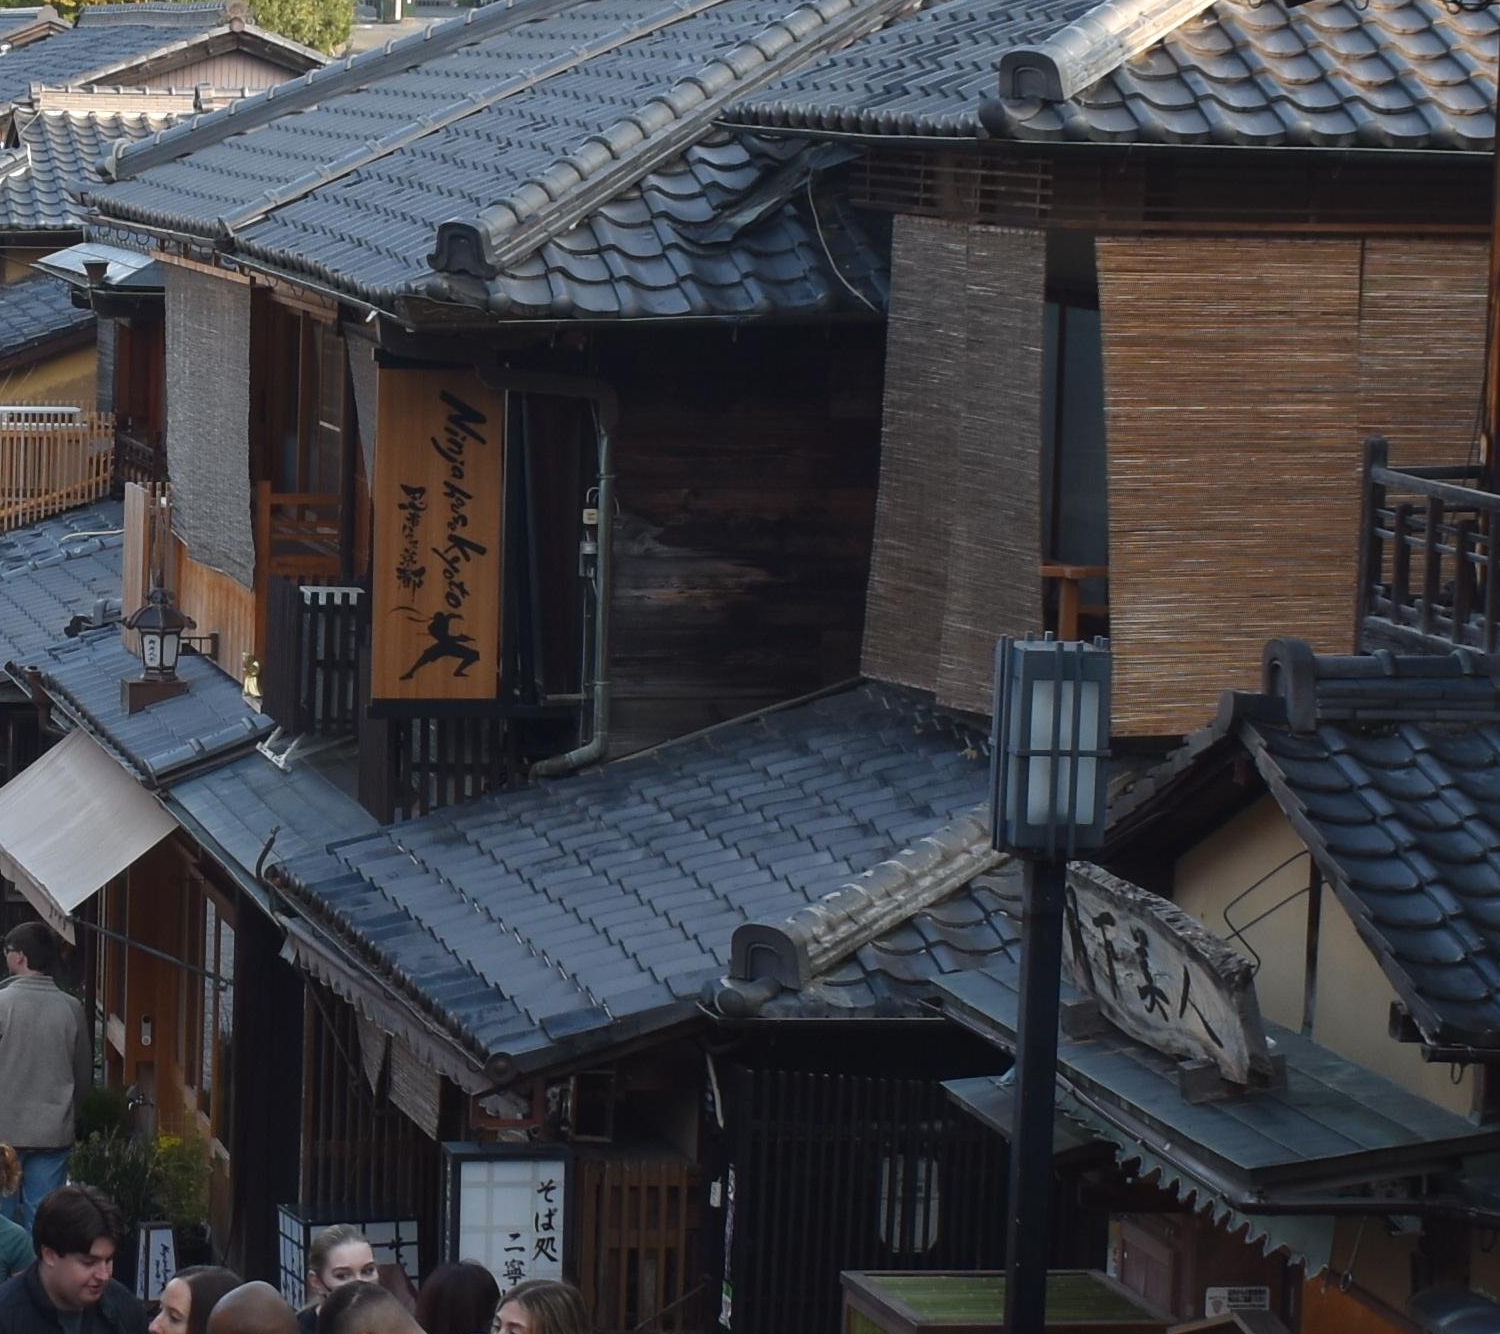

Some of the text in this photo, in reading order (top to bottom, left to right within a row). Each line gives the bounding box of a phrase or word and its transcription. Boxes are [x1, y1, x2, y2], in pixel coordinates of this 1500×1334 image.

[431, 389, 488, 480] Ninja
[431, 533, 488, 609] Kyoto
[532, 1178, 559, 1263] そば処
[502, 1232, 527, 1297] 二寧
